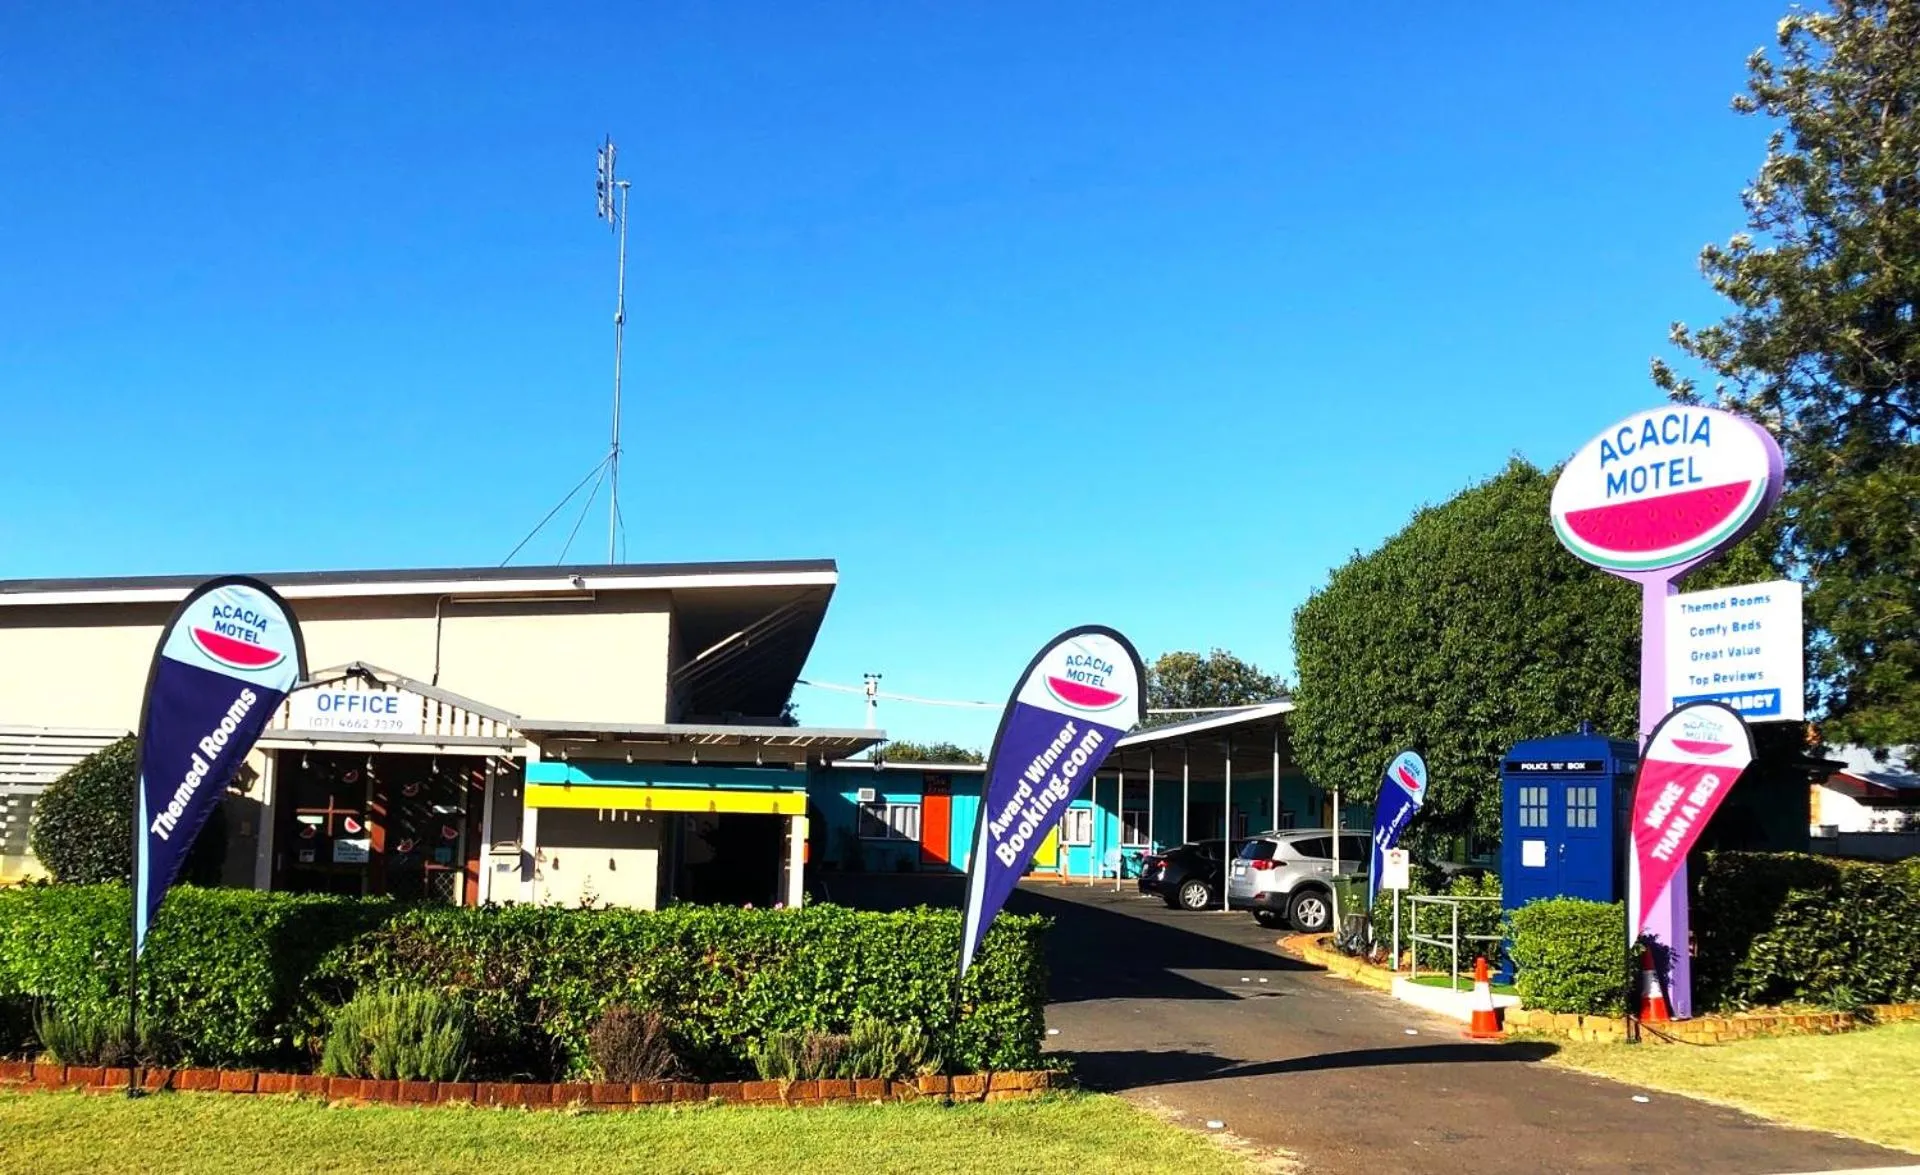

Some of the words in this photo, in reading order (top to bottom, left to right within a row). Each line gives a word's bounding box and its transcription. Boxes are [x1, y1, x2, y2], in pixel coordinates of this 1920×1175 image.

[1600, 413, 1711, 470] ACACIA
[1606, 456, 1703, 498] MOTEL
[1681, 600, 1726, 614] Themed
[1730, 595, 1771, 607] Rooms
[212, 604, 267, 633] ACACIA
[1690, 623, 1727, 637] Comfy
[1732, 620, 1762, 632] Beds
[214, 620, 260, 645] MOTEL
[1066, 654, 1113, 677] ACACIA
[1691, 649, 1723, 662] Great
[1728, 646, 1761, 658] Value
[1066, 667, 1106, 688] MOTEL
[1689, 675, 1709, 687] Top
[1713, 670, 1764, 684] Reviews
[317, 693, 399, 714] OFFICE
[309, 717, 334, 729] (07)
[338, 719, 369, 729] 4662
[151, 752, 210, 841] Themed
[199, 687, 257, 760] Rooms
[1521, 762, 1549, 770] POLICE
[1567, 762, 1586, 770] BOX
[989, 778, 1033, 841] Award
[1024, 720, 1077, 784] Winner
[1688, 772, 1720, 807] BED
[995, 728, 1104, 868] Booking.com
[1644, 781, 1685, 829] MORE
[1681, 805, 1700, 822] A
[1650, 815, 1691, 861] THAN
